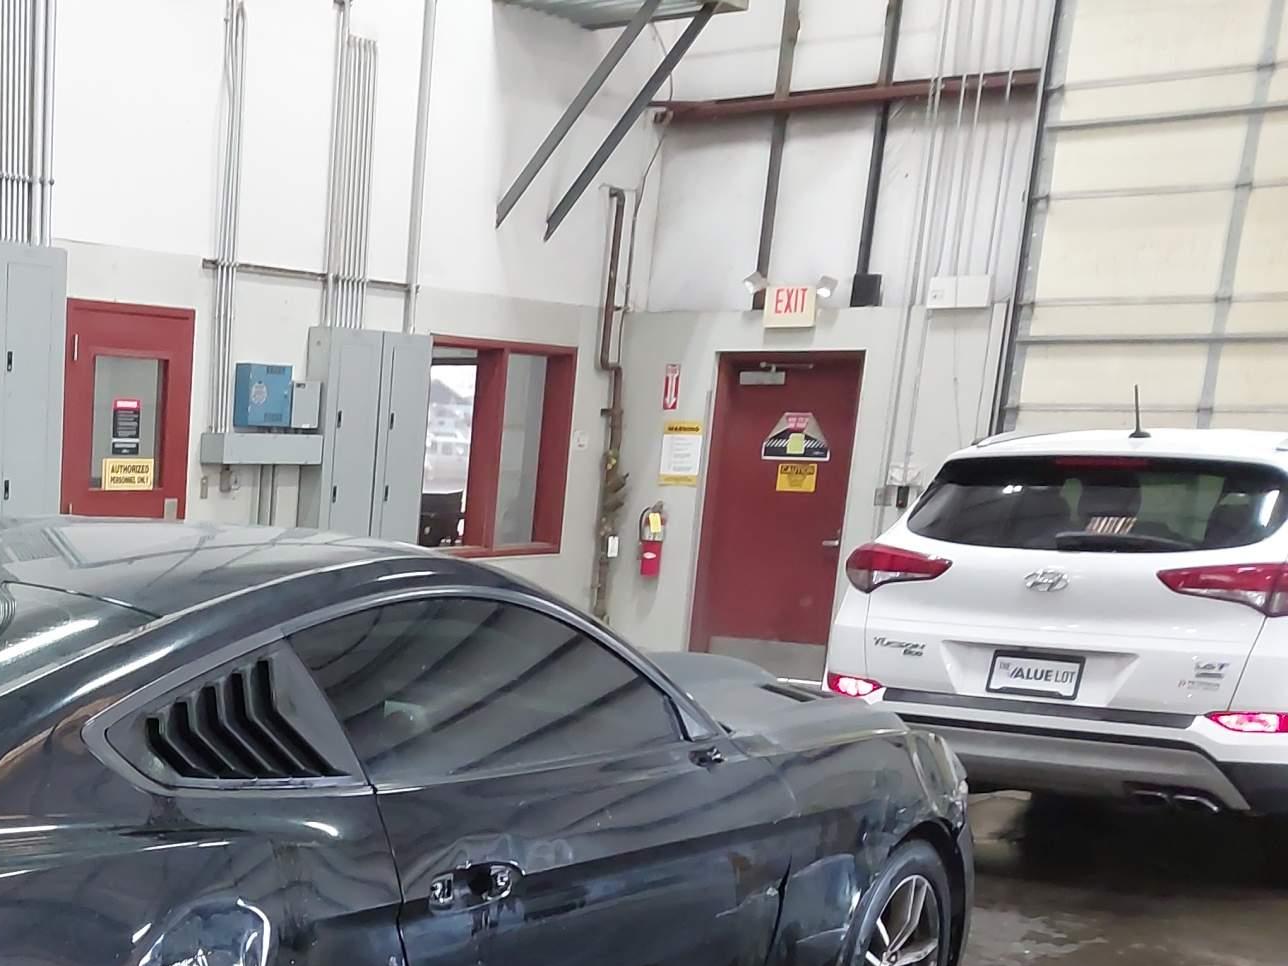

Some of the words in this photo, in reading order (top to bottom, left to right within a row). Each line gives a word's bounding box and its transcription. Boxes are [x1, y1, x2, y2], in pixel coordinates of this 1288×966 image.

[774, 287, 809, 314] EXIT
[110, 464, 150, 474] AUTHORIZED
[110, 475, 136, 484] PERSONNEL
[1054, 670, 1077, 684] LOT
